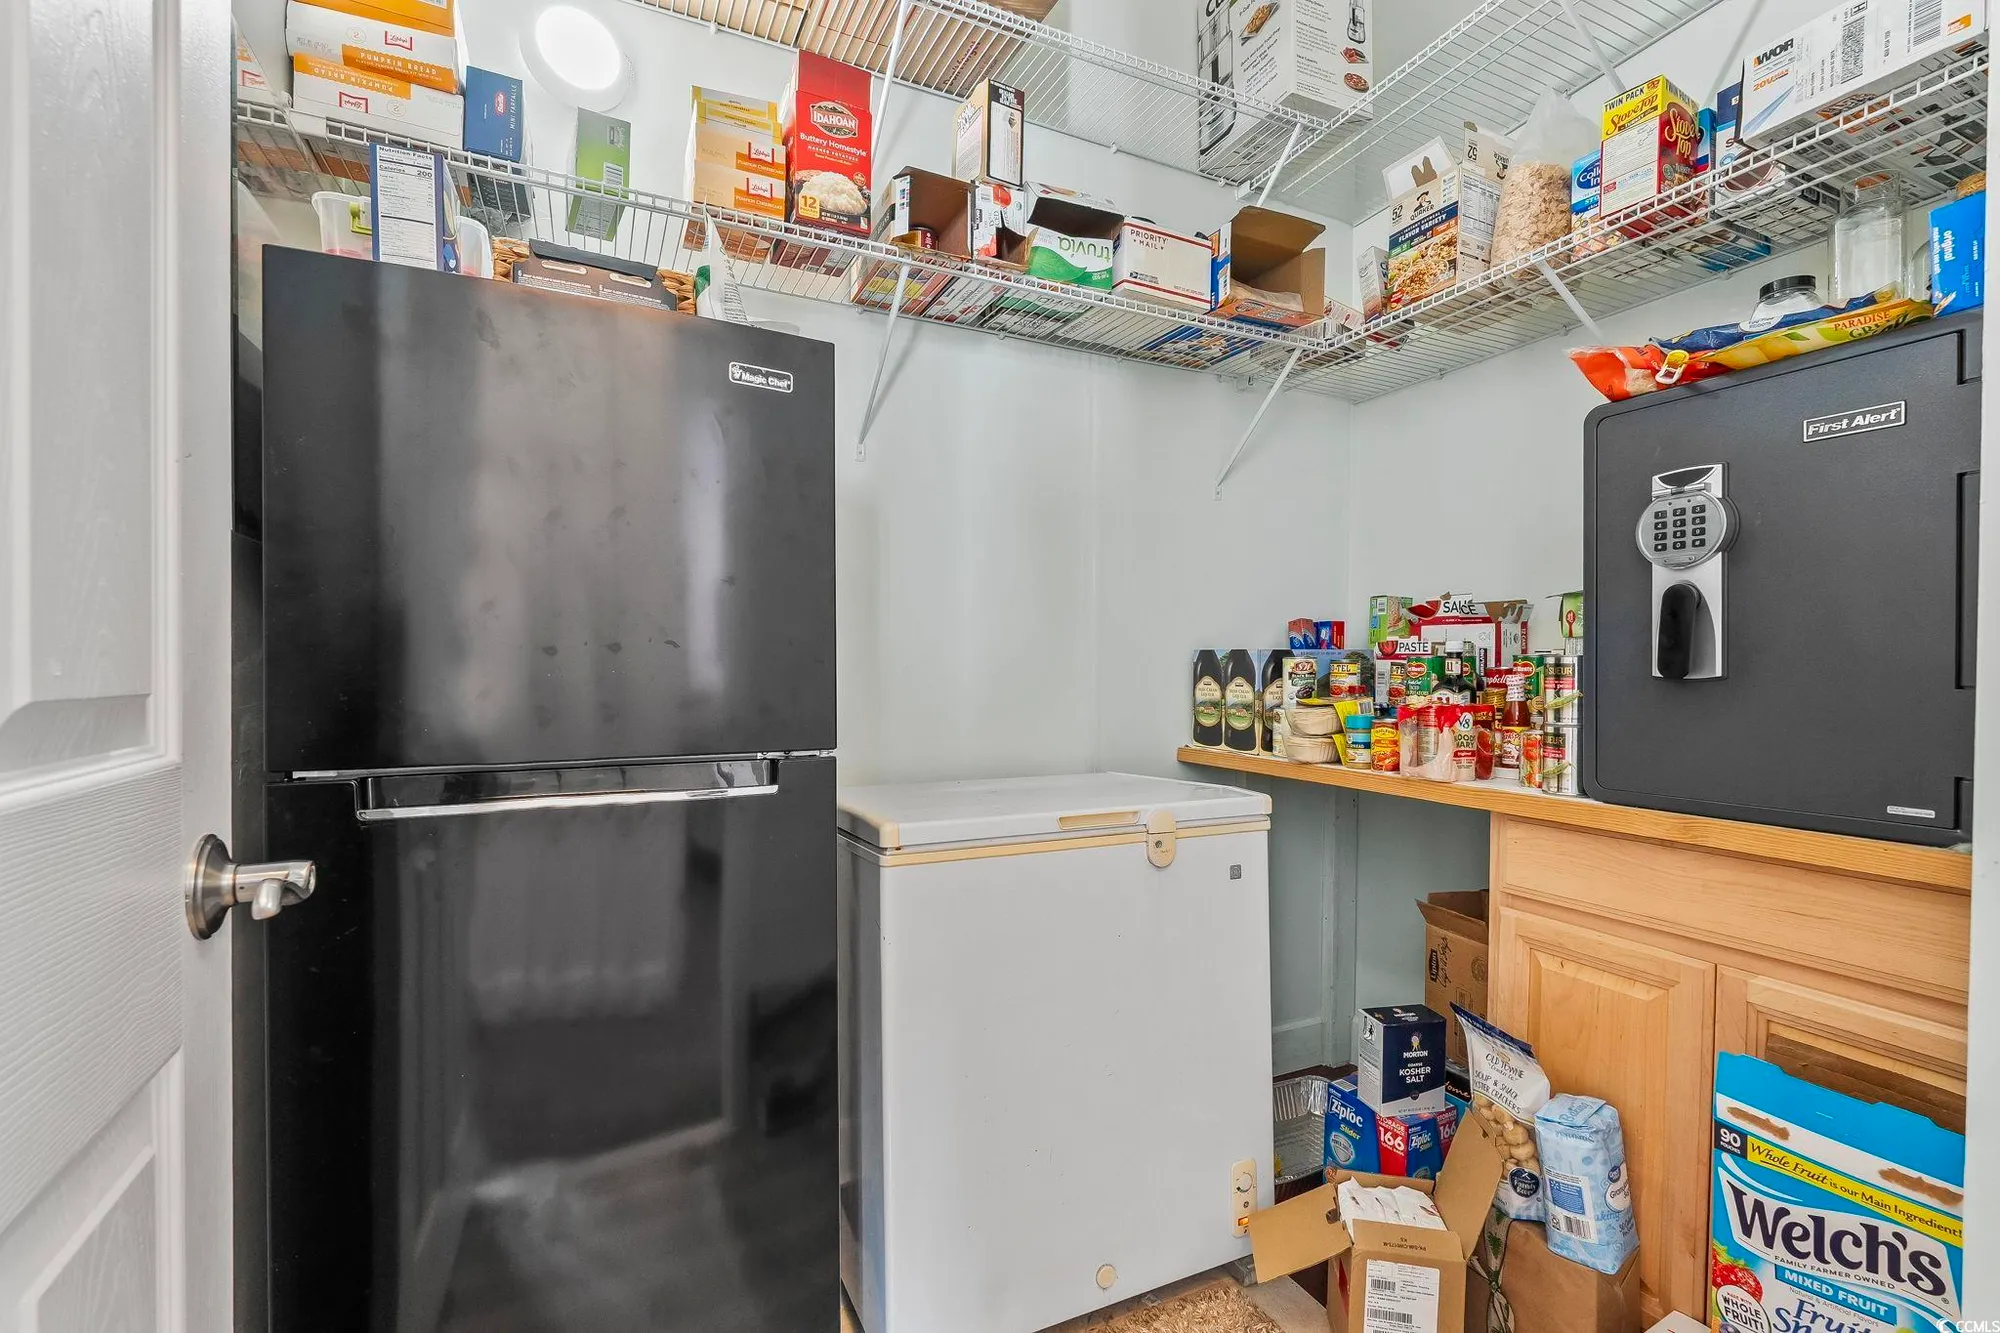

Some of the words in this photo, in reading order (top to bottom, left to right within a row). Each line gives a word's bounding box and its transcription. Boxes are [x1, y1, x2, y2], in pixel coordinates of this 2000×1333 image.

[313, 66, 345, 81] BREAD
[360, 52, 403, 68] PUMPKIN
[407, 62, 437, 76] BREAD
[351, 75, 393, 93] PUMPKIN
[1604, 98, 1623, 113] TWIN
[1625, 87, 1645, 102] PACK
[813, 110, 856, 130] IDAHOAN
[1606, 104, 1640, 136] Stove
[1664, 107, 1696, 143] Stove
[379, 146, 411, 157] Nutrition
[412, 151, 433, 160] Facts
[800, 133, 828, 147] Buttery
[828, 138, 867, 157] Homestyle
[1467, 145, 1478, 160] 52
[1675, 134, 1692, 159] Top
[379, 164, 406, 174] Calories
[416, 169, 433, 178] 200
[1580, 165, 1601, 182] Coll
[801, 195, 817, 210] 12
[1392, 204, 1403, 221] 52
[1410, 203, 1435, 221] QUAKER
[1130, 229, 1167, 245] PRIORITY
[1398, 226, 1420, 242] FLAVOR
[1420, 214, 1447, 232] VARIETY
[1139, 240, 1158, 250] MAIL
[1943, 230, 1956, 262] original
[1834, 311, 1891, 332] PARADISE
[742, 372, 767, 385] Magic
[767, 376, 788, 389] Chef
[1807, 418, 1849, 437] First
[1850, 408, 1898, 429] Alert
[1399, 641, 1429, 653] PASTE
[1403, 1050, 1429, 1059] MORTON
[1399, 1066, 1431, 1076] KOSHER
[1485, 1053, 1500, 1066] OLD
[1500, 1060, 1524, 1079] TOWNE
[1405, 1075, 1425, 1084] SALT
[1475, 1070, 1492, 1082] SOUP
[1493, 1079, 1498, 1087] &
[1501, 1082, 1518, 1100] SNACK
[1474, 1080, 1490, 1093] YSTER
[1491, 1088, 1521, 1114] CRACKERS
[1331, 1098, 1364, 1128] Ziploc
[1559, 1100, 1593, 1123] Baking
[1340, 1123, 1361, 1140] Slider
[1376, 1114, 1406, 1133] STORAGE
[1440, 1123, 1457, 1140] 166
[1379, 1126, 1405, 1152] 166
[1410, 1132, 1432, 1149] Ziploc
[1720, 1128, 1741, 1148] 90
[1720, 1142, 1741, 1154] POUCHES
[1750, 1142, 1790, 1168] Whole
[1792, 1163, 1829, 1186] Fruit
[1829, 1180, 1838, 1189] is
[1840, 1185, 1860, 1198] our
[1861, 1191, 1892, 1211] Main
[1893, 1204, 1963, 1240] Ingredient!
[1726, 1180, 1948, 1298] Welch's
[1774, 1255, 1808, 1269] FAMILY
[1810, 1265, 1851, 1280] FARMER
[1853, 1274, 1896, 1291] OWNED
[1784, 1268, 1834, 1297] MIXED
[1837, 1290, 1889, 1318] FRUIT
[1721, 1294, 1762, 1320] WHOLE
[1789, 1286, 1815, 1303] Natural
[1822, 1299, 1851, 1314] Artificial
[1852, 1311, 1880, 1328] Flavors
[1724, 1306, 1764, 1333] FRUIT!
